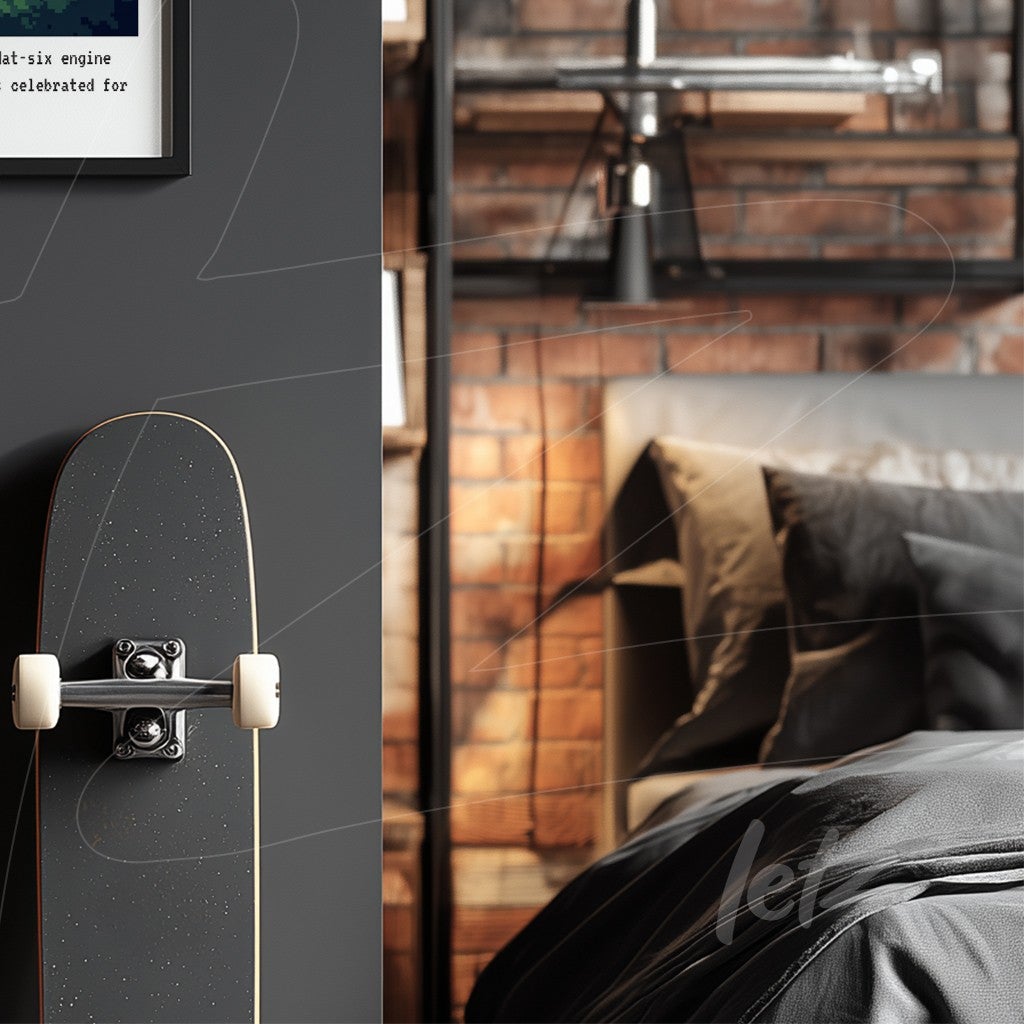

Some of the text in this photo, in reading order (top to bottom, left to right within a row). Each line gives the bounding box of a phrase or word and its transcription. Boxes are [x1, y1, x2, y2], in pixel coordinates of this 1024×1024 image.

[60, 50, 112, 68] engine
[10, 77, 95, 93] celebrated
[103, 77, 128, 92] for
